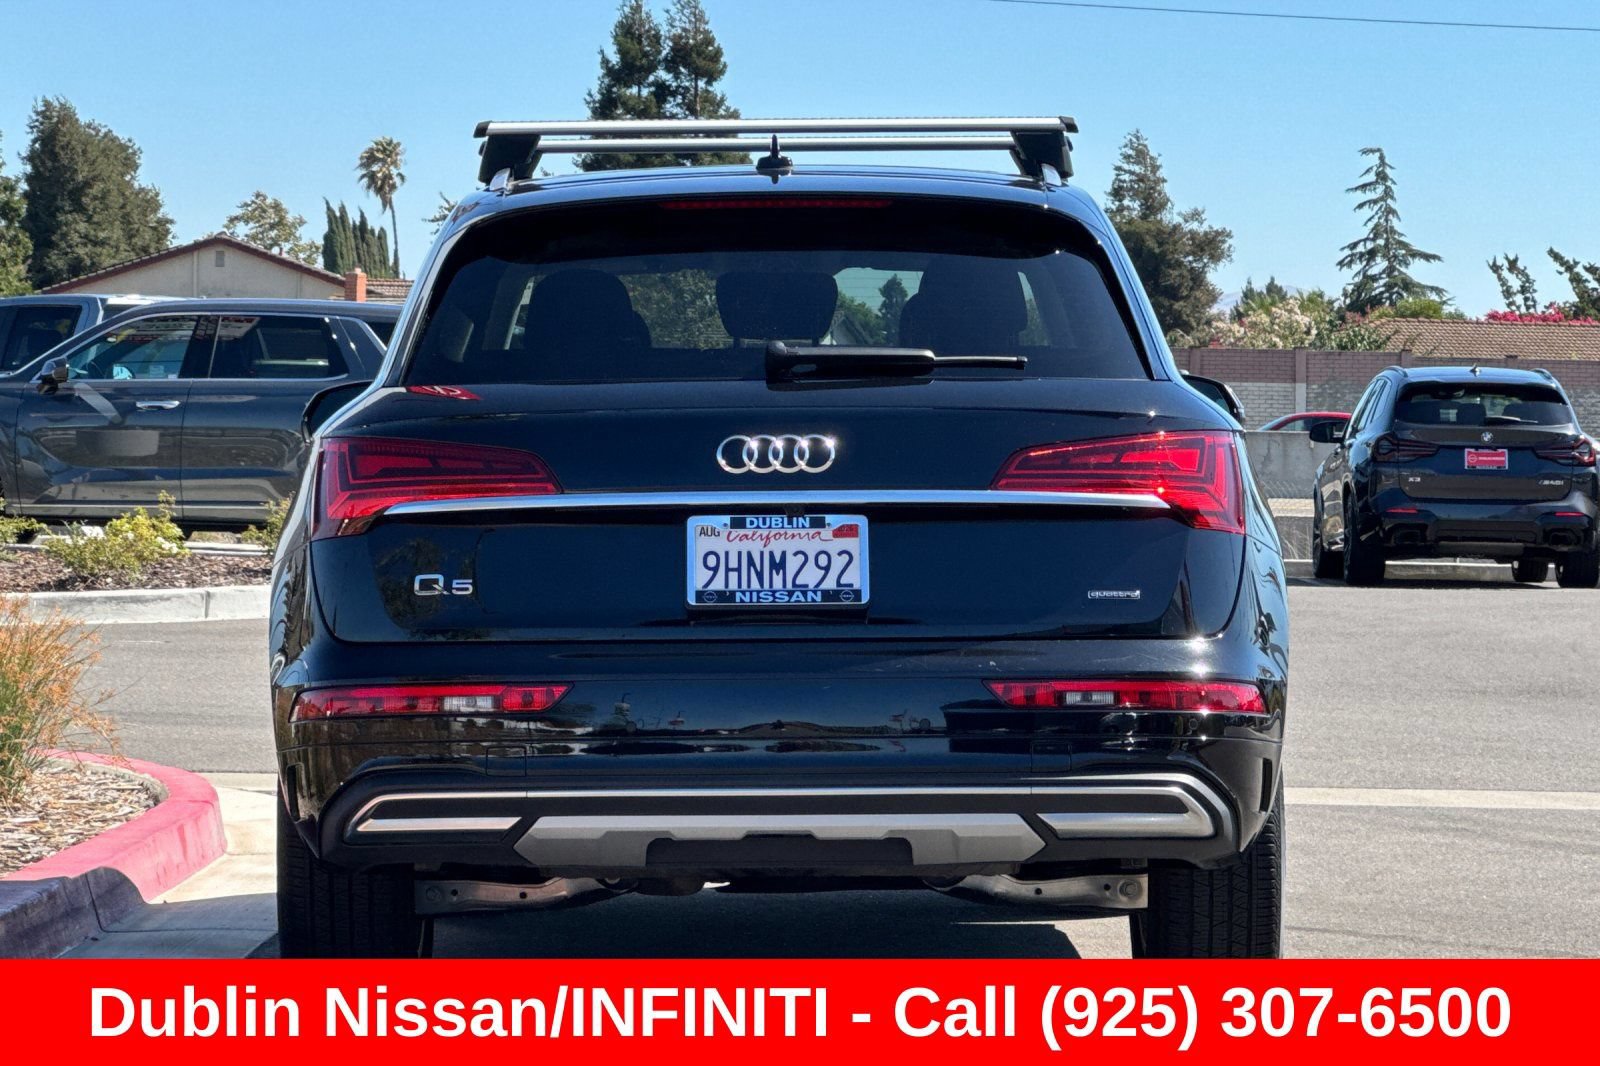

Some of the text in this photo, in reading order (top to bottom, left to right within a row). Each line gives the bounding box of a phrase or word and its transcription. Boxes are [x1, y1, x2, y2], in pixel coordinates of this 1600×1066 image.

[745, 516, 810, 529] DUBLIN
[699, 526, 721, 537] AUG
[726, 529, 834, 548] California
[702, 550, 854, 590] 9HNM292
[413, 574, 473, 596] Q5
[735, 590, 822, 603] NISSAN
